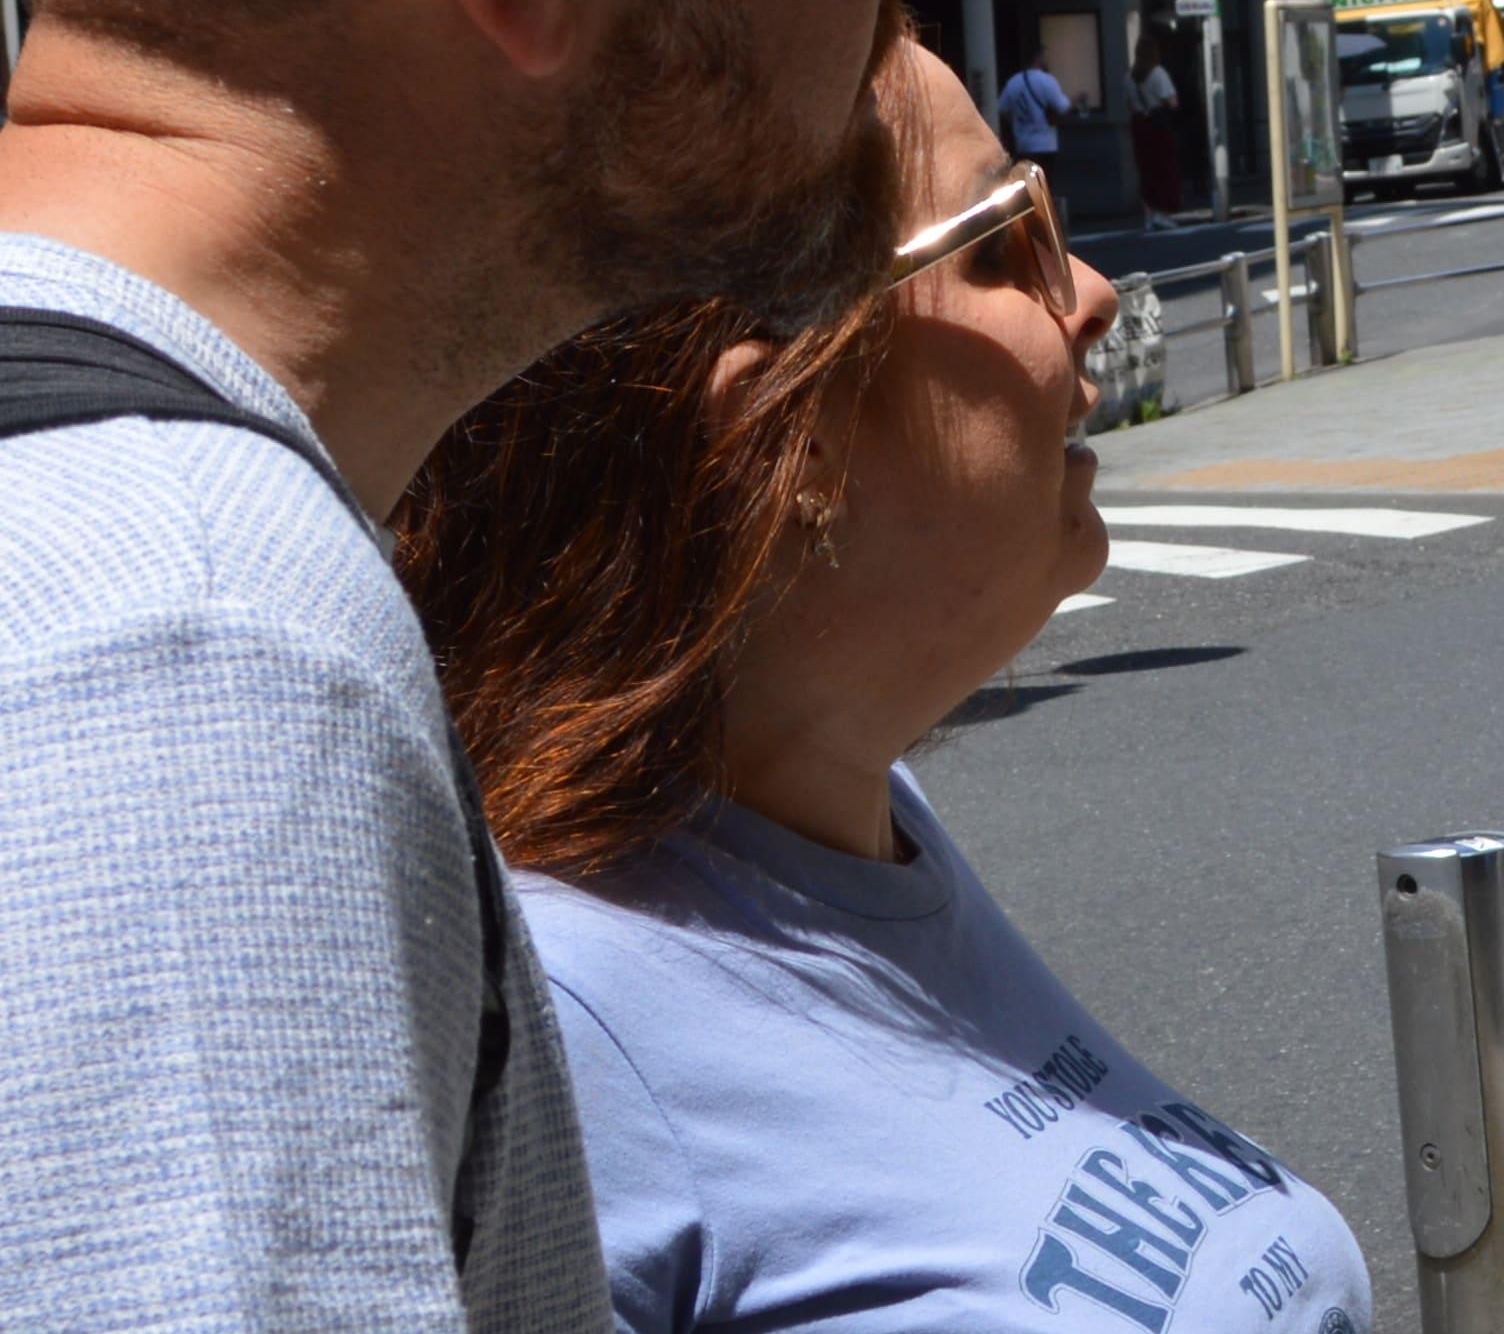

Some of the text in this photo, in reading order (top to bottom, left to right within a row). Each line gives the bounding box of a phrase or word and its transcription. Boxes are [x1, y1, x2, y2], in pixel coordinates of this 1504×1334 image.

[983, 1033, 1110, 1140] YOU STOLE
[1238, 1235, 1310, 1321] TO MY
